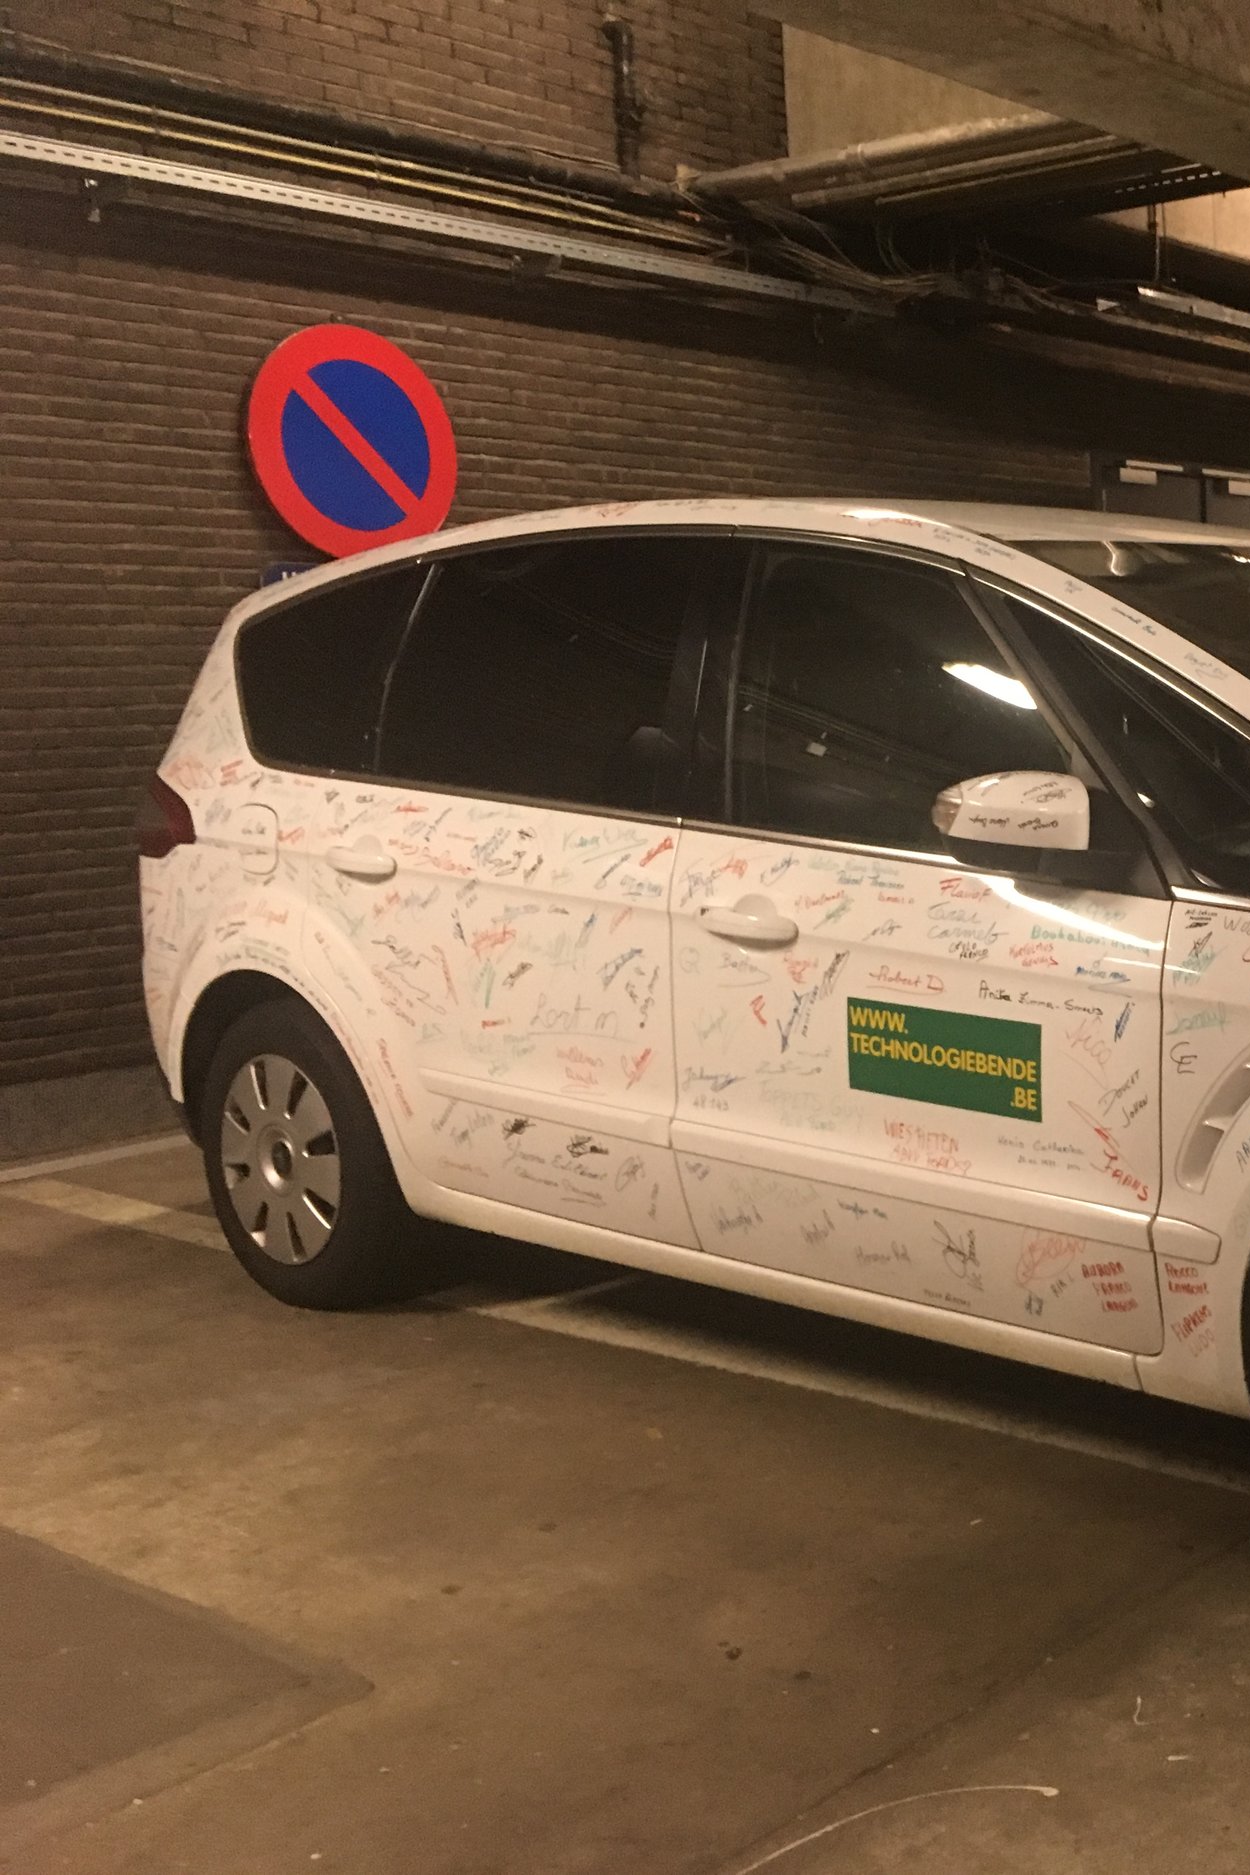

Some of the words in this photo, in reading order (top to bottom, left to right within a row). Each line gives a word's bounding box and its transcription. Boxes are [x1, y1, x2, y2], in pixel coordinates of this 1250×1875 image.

[850, 1005, 909, 1034] WWW.
[850, 1032, 1038, 1083] TECHNOLOGIEBENDE
[1010, 1087, 1038, 1111] .BE
